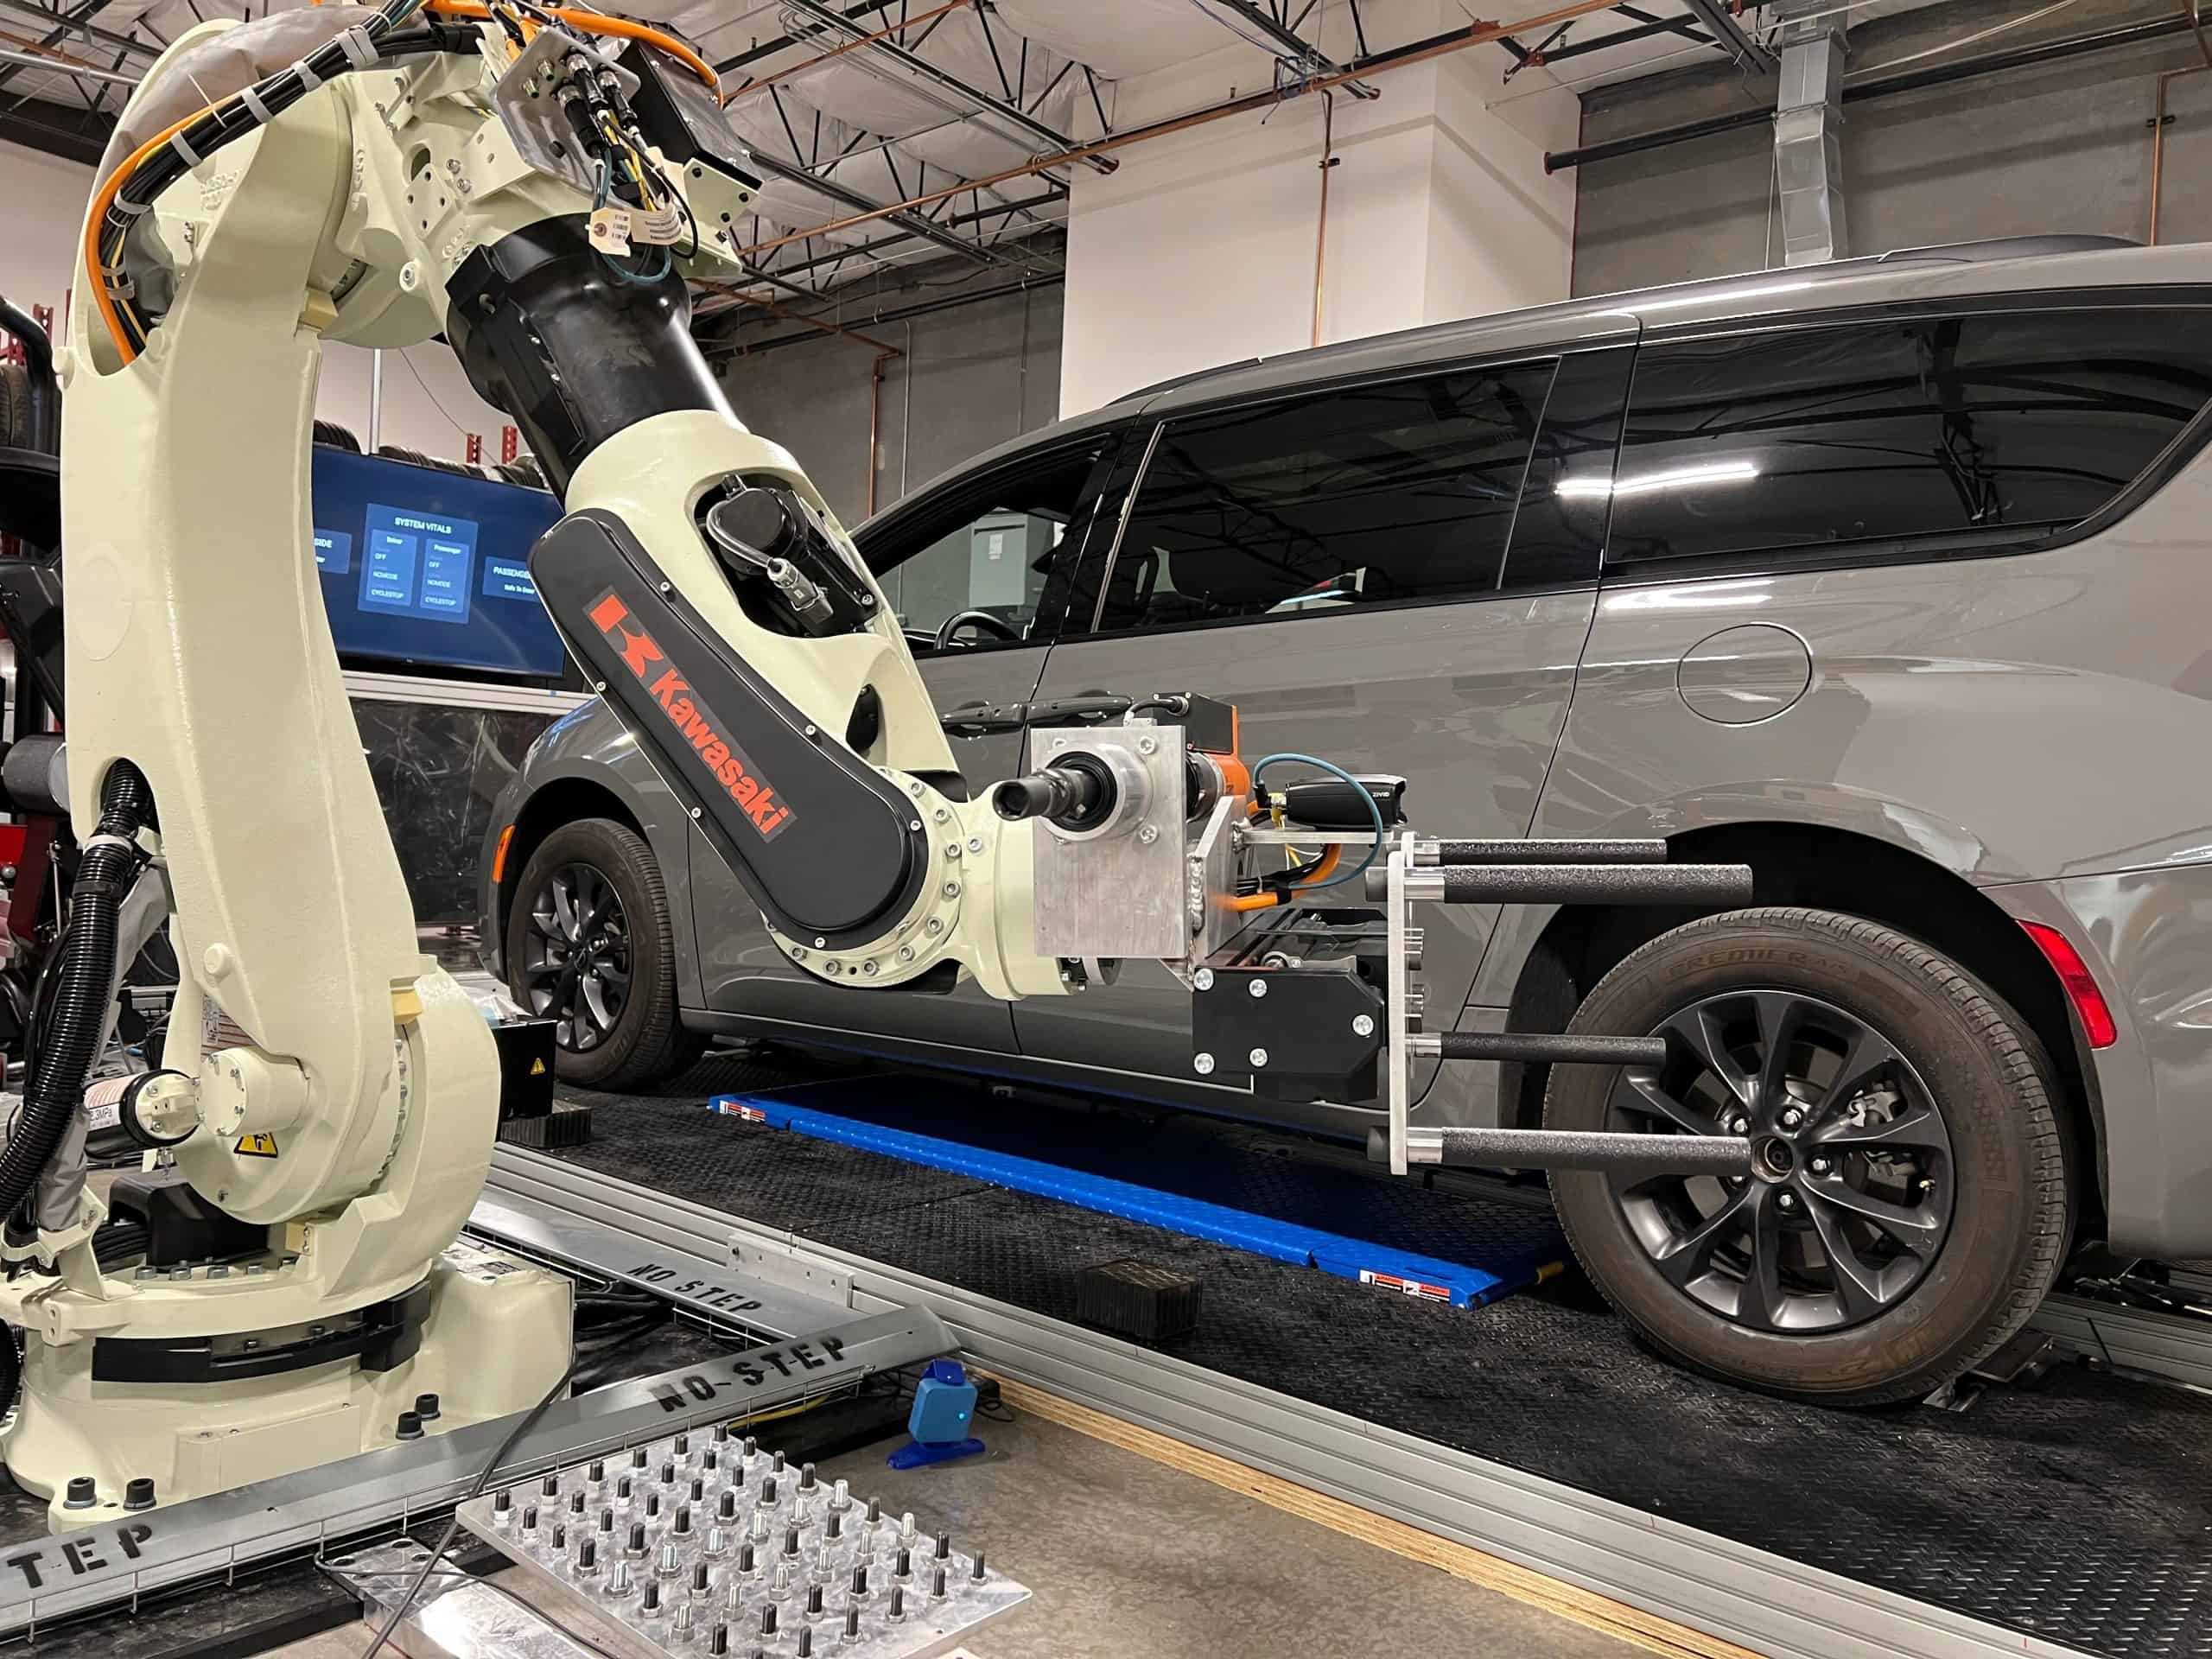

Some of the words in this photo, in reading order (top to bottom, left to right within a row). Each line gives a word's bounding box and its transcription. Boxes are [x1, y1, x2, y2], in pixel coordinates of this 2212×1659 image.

[314, 537, 333, 549] SIDE
[394, 517, 425, 531] SYSTEM
[426, 523, 452, 534] VITALS
[650, 669, 788, 835] Kawasaki
[626, 1263, 677, 1282] NO
[674, 1280, 762, 1313] STEP
[7, 1523, 153, 1589] TEP
